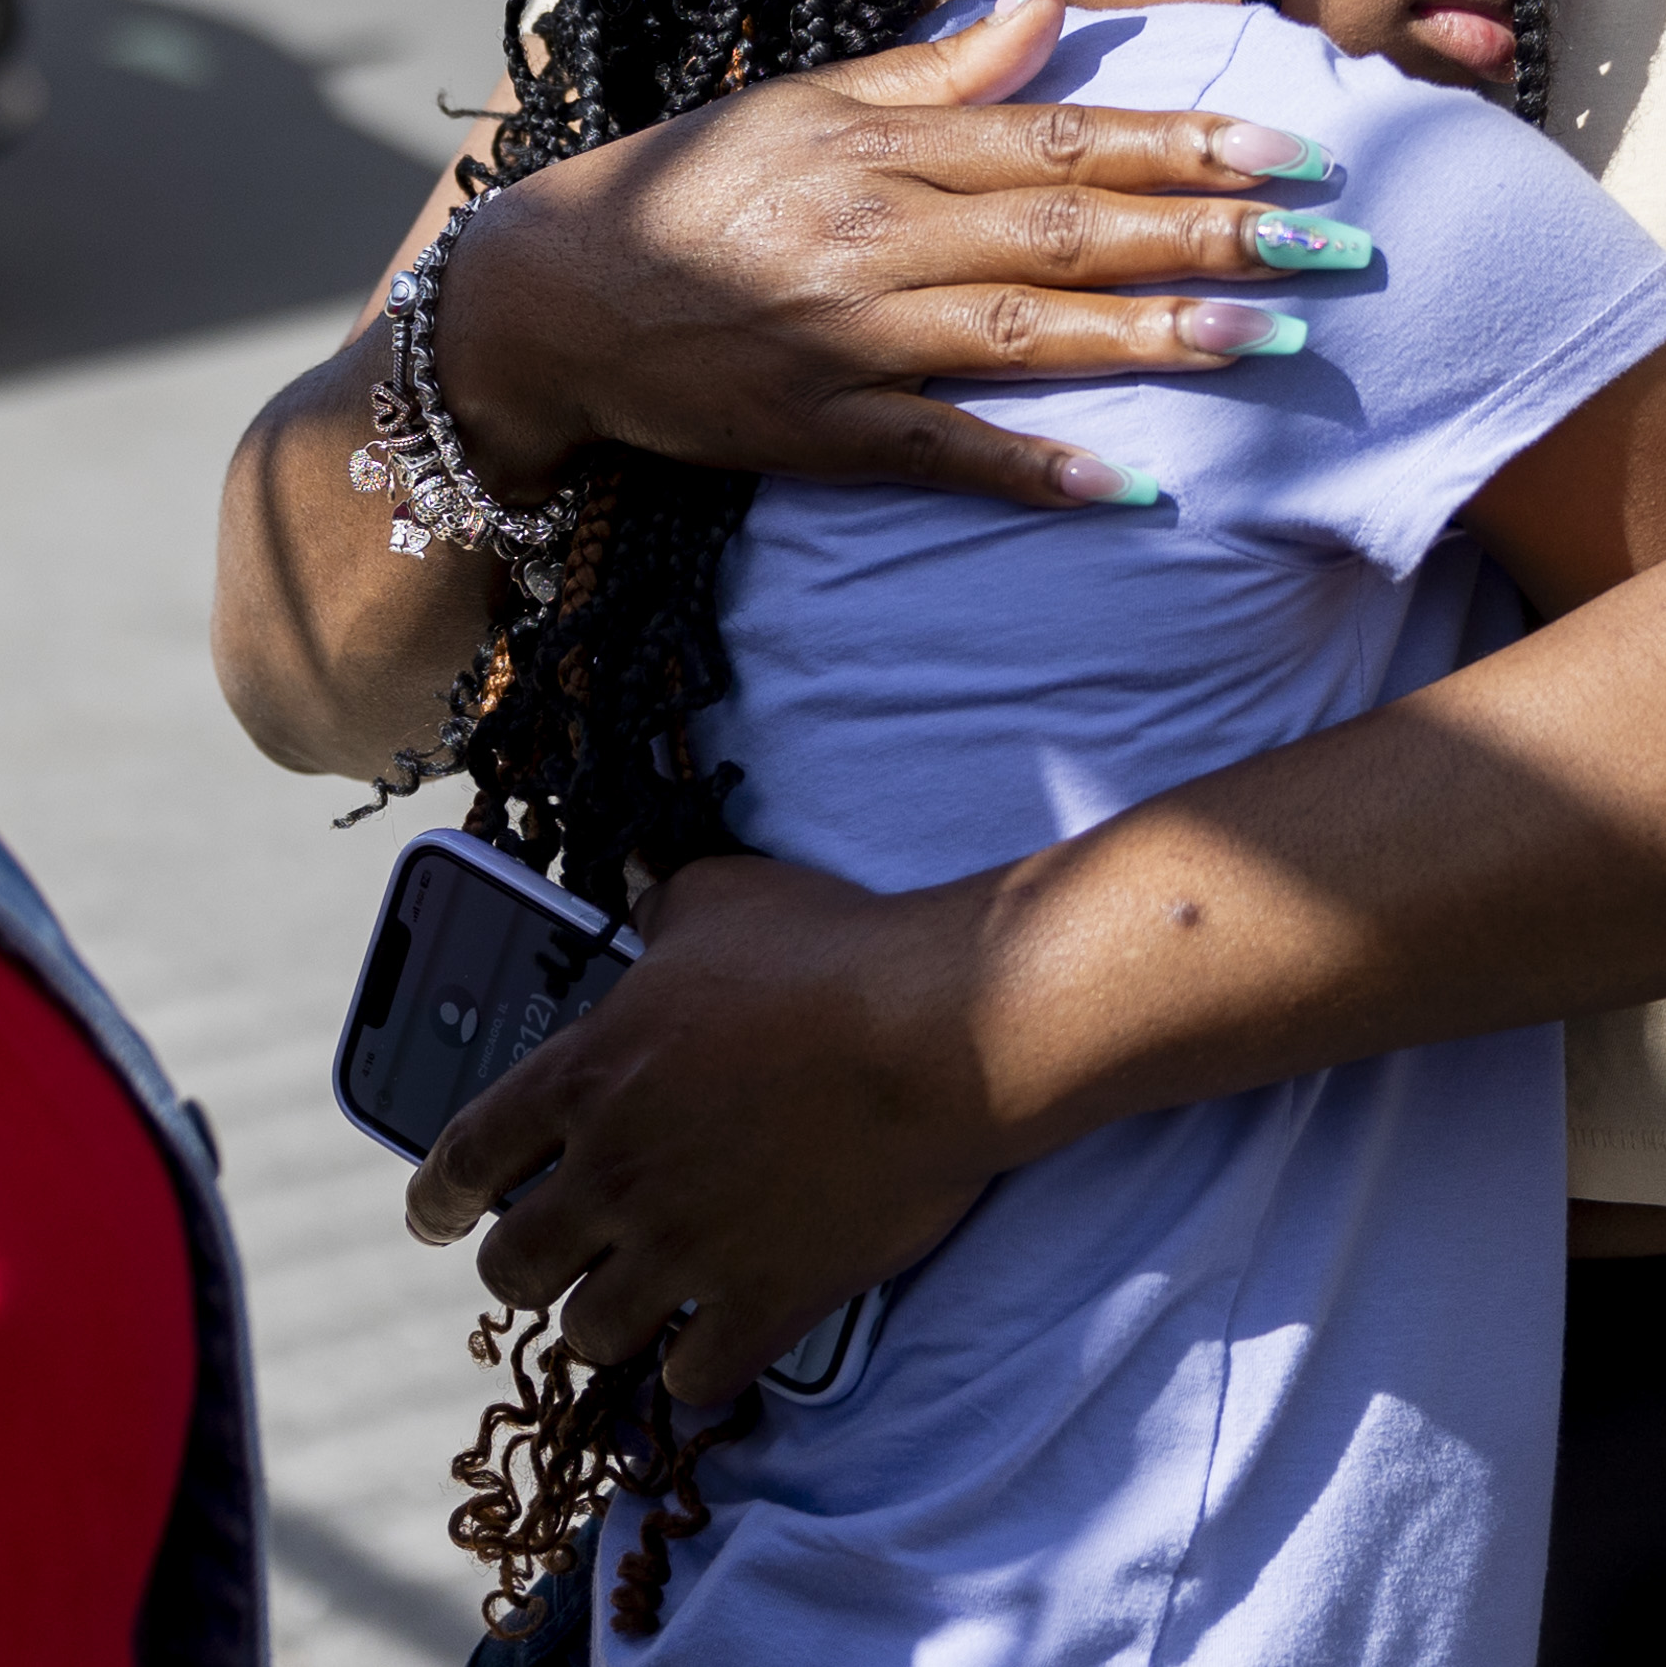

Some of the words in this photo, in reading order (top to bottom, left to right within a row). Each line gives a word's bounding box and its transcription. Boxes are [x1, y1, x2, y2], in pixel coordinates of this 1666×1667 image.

[478, 1018, 505, 1078] CHICAGO,
[497, 1002, 509, 1015] IL
[508, 993, 558, 1067] 312)
